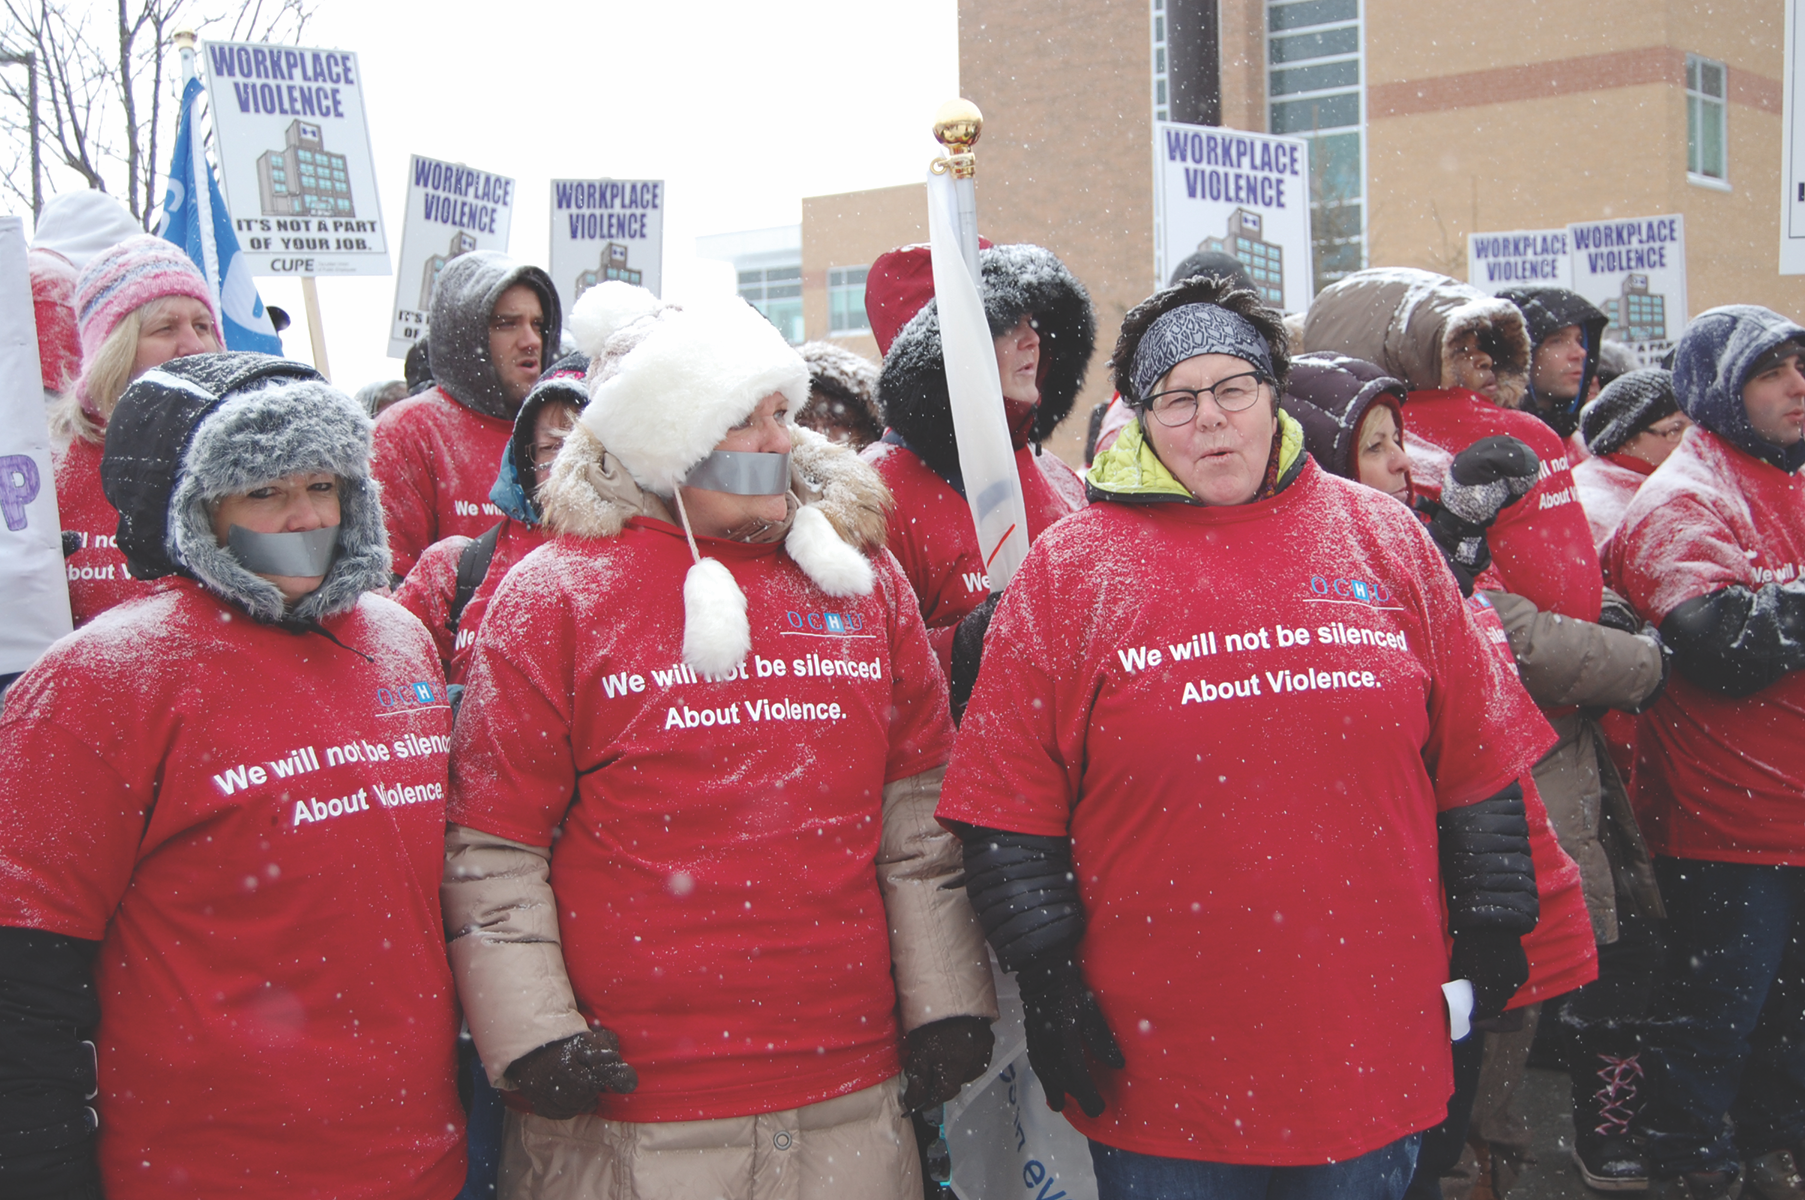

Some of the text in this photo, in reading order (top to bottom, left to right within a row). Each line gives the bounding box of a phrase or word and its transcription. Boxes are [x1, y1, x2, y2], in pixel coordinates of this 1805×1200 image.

[209, 44, 355, 85] WORKPLACE
[233, 80, 345, 119] VIOLENCE
[1166, 130, 1300, 176] WORKPLACE
[414, 157, 511, 207] WORKPLACE
[555, 182, 660, 210] WORKPLACE
[1184, 166, 1286, 208] VIOLENCE
[235, 217, 377, 233] IT'S NOT A PART
[423, 192, 498, 234] VIOLENCE
[568, 212, 648, 240] VIOLENCE
[249, 236, 373, 251] OF YOUR JOB.
[1474, 233, 1568, 260] WORKPLACE
[1573, 218, 1678, 250] WORKPLACE
[270, 257, 315, 272] CUPE
[1486, 257, 1559, 282] VIOLENCE
[1587, 246, 1667, 274] VIOLENCE
[398, 310, 423, 324] IT'S
[454, 500, 479, 517] We
[1538, 486, 1571, 511] About
[68, 563, 116, 581] bout
[1772, 561, 1795, 584] will
[1310, 576, 1390, 602] OCHU
[786, 610, 863, 633] OCHU
[1118, 621, 1408, 672] We will not be silenced
[601, 671, 646, 699] We
[650, 662, 698, 688] will
[754, 654, 787, 678] be
[792, 653, 882, 680] silenced
[1180, 667, 1382, 705] About Violence.
[664, 697, 847, 730] About Violence.
[213, 764, 268, 796] We
[270, 745, 321, 779] will
[325, 739, 367, 767] not
[361, 738, 391, 763] be
[293, 781, 445, 827] About Violence.
